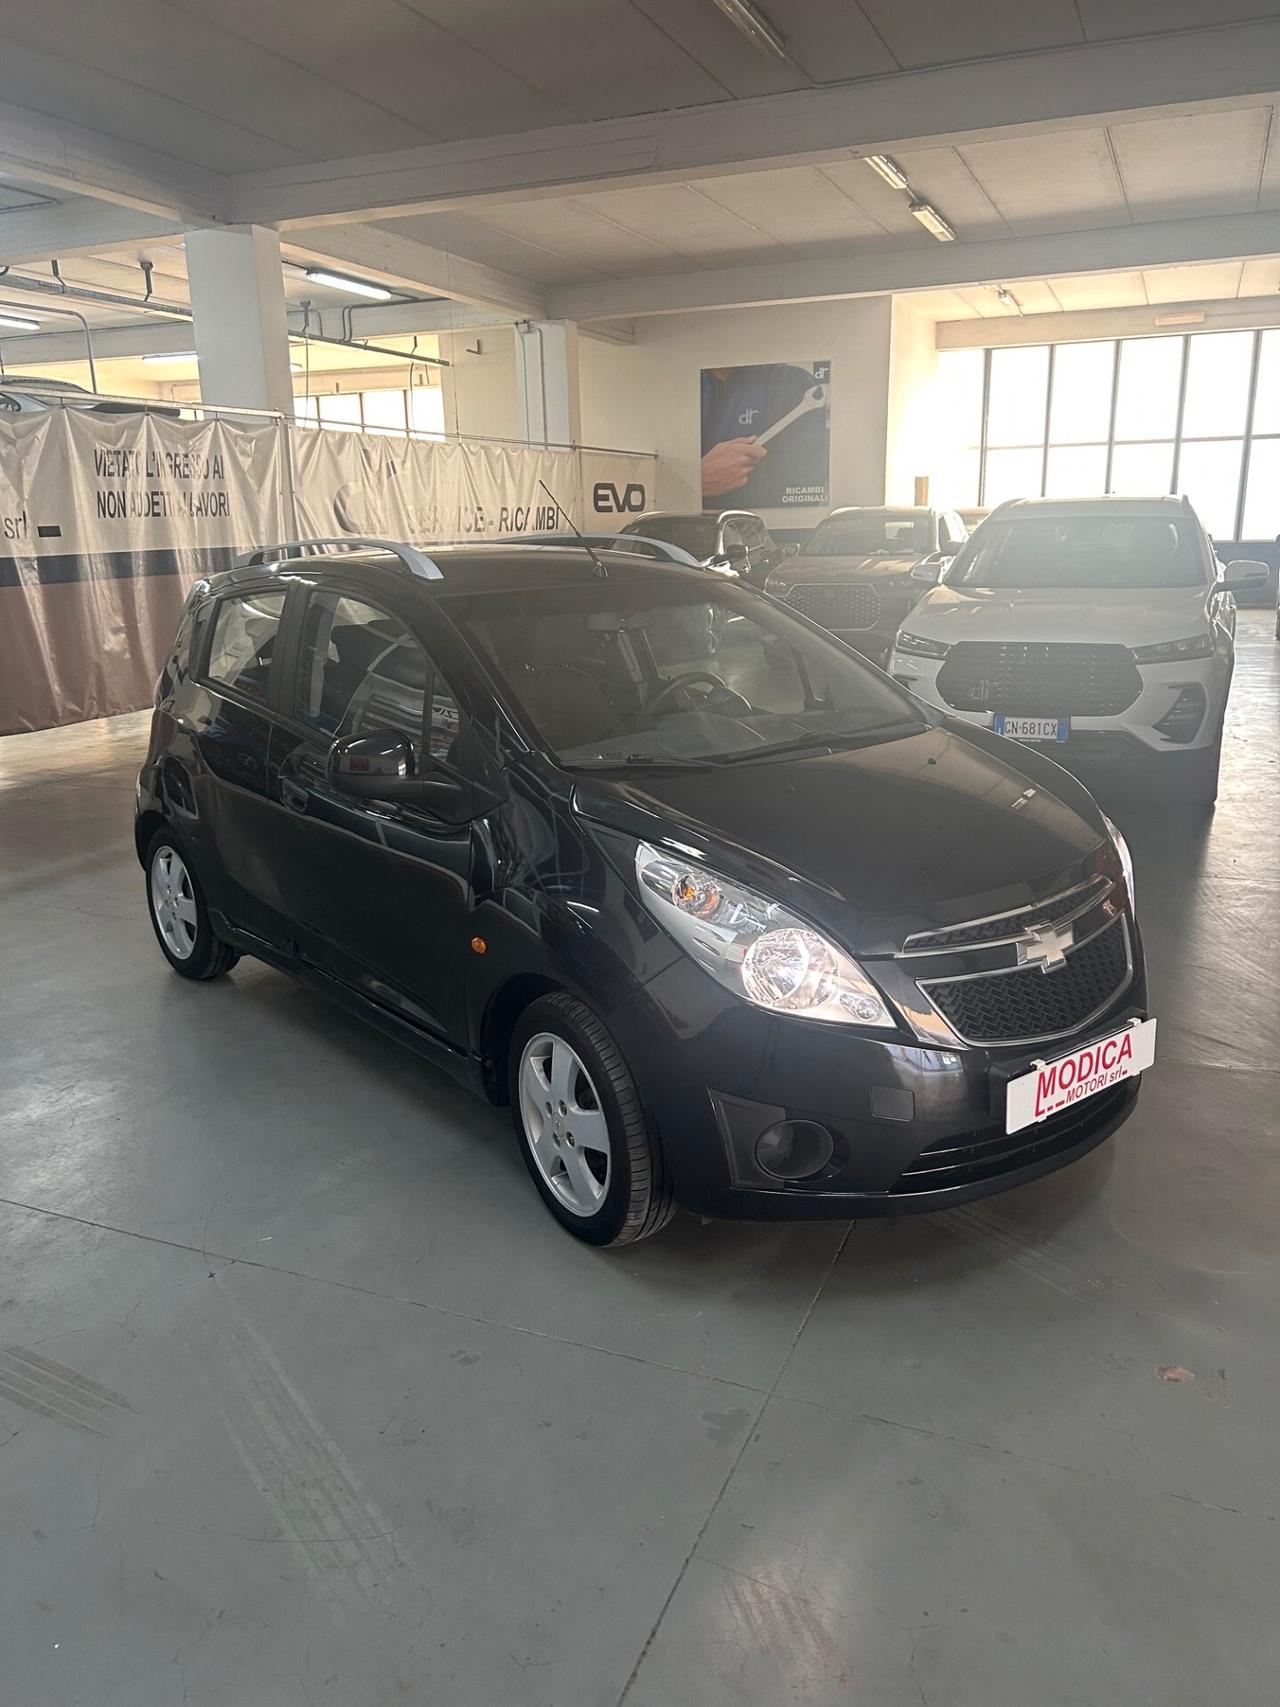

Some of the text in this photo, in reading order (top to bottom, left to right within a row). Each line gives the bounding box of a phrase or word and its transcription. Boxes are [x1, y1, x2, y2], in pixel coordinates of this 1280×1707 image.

[814, 367, 829, 379] dr
[738, 408, 759, 424] dr
[213, 454, 225, 480] AI
[97, 491, 127, 518] NON
[130, 490, 175, 518] ADDETT
[189, 491, 231, 518] LAVORI
[593, 482, 646, 512] EVO
[782, 494, 828, 503] ORIGINALI
[785, 486, 824, 495] RICAMBI
[4, 510, 27, 540] srl
[499, 505, 560, 533] RICAMBI
[1036, 1033, 1132, 1104] MODICA
[1066, 1065, 1122, 1104] MOTORI srl
